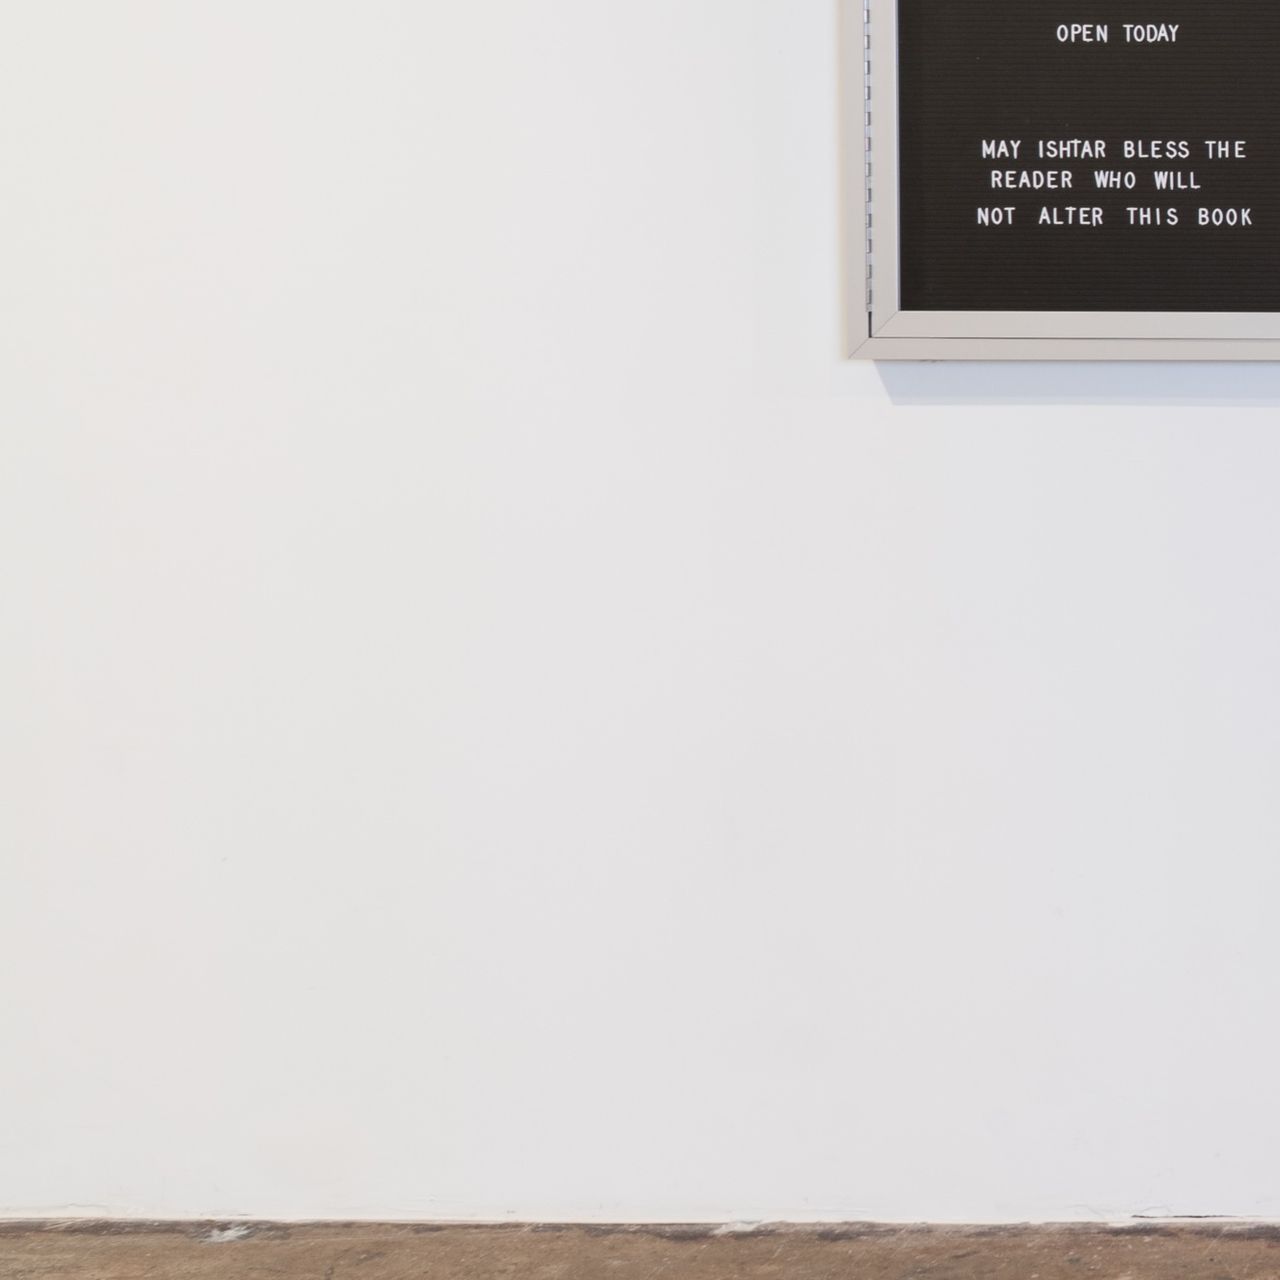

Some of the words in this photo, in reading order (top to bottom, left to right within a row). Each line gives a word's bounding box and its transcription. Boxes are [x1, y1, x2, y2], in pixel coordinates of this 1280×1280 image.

[1057, 24, 1107, 42] OPEN
[1123, 24, 1178, 42] TODAY
[982, 140, 1021, 159] MAY
[1039, 139, 1105, 158] ISHTAR
[1124, 140, 1189, 159] BLESS
[1205, 141, 1245, 159] THE
[992, 170, 1072, 189] READER
[1094, 170, 1135, 189] WHO
[1154, 171, 1200, 190] WILL
[978, 207, 1015, 226] NOT
[1039, 207, 1102, 226] ALTER
[1127, 207, 1178, 225] THIS
[1199, 208, 1252, 225] BOOK
